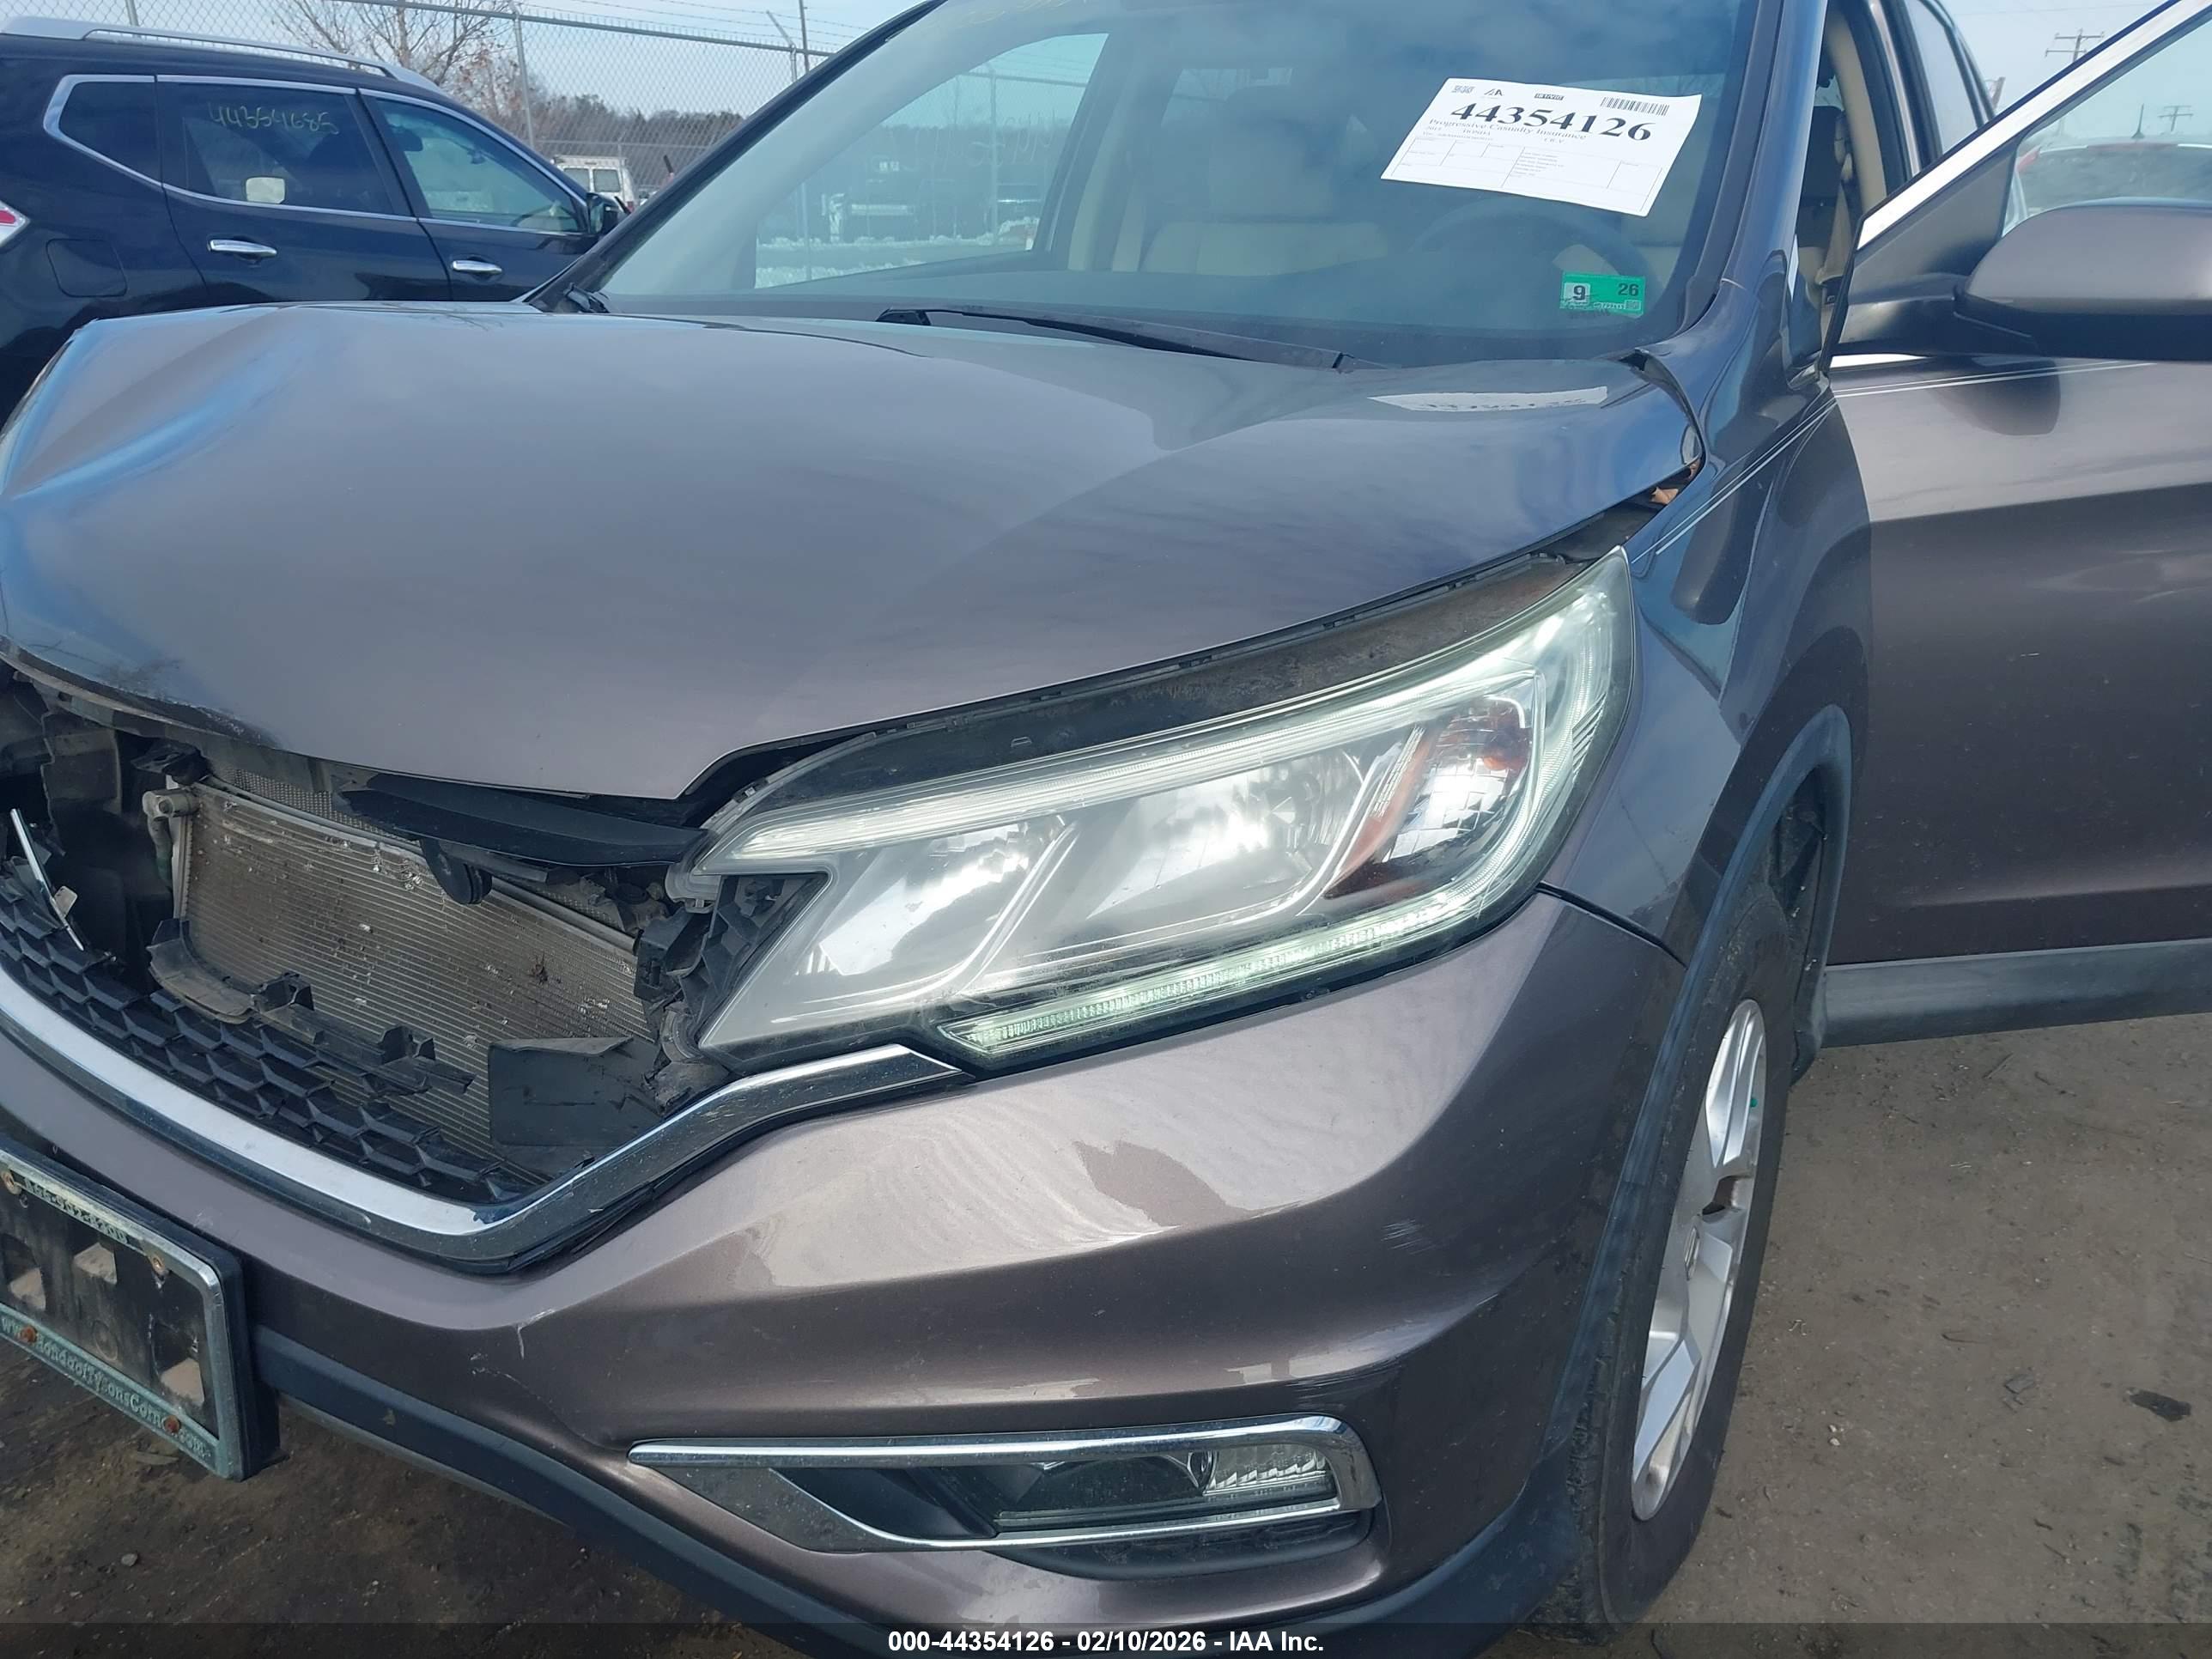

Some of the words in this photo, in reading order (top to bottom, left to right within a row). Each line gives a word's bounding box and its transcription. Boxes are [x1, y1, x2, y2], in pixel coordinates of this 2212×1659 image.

[1429, 118, 1487, 129] Progressive
[1489, 124, 1534, 134] Casualty
[1536, 129, 1587, 140] Insurance
[1450, 102, 1656, 142] 44354126
[1572, 284, 1586, 301] 9
[1618, 283, 1639, 297] 26
